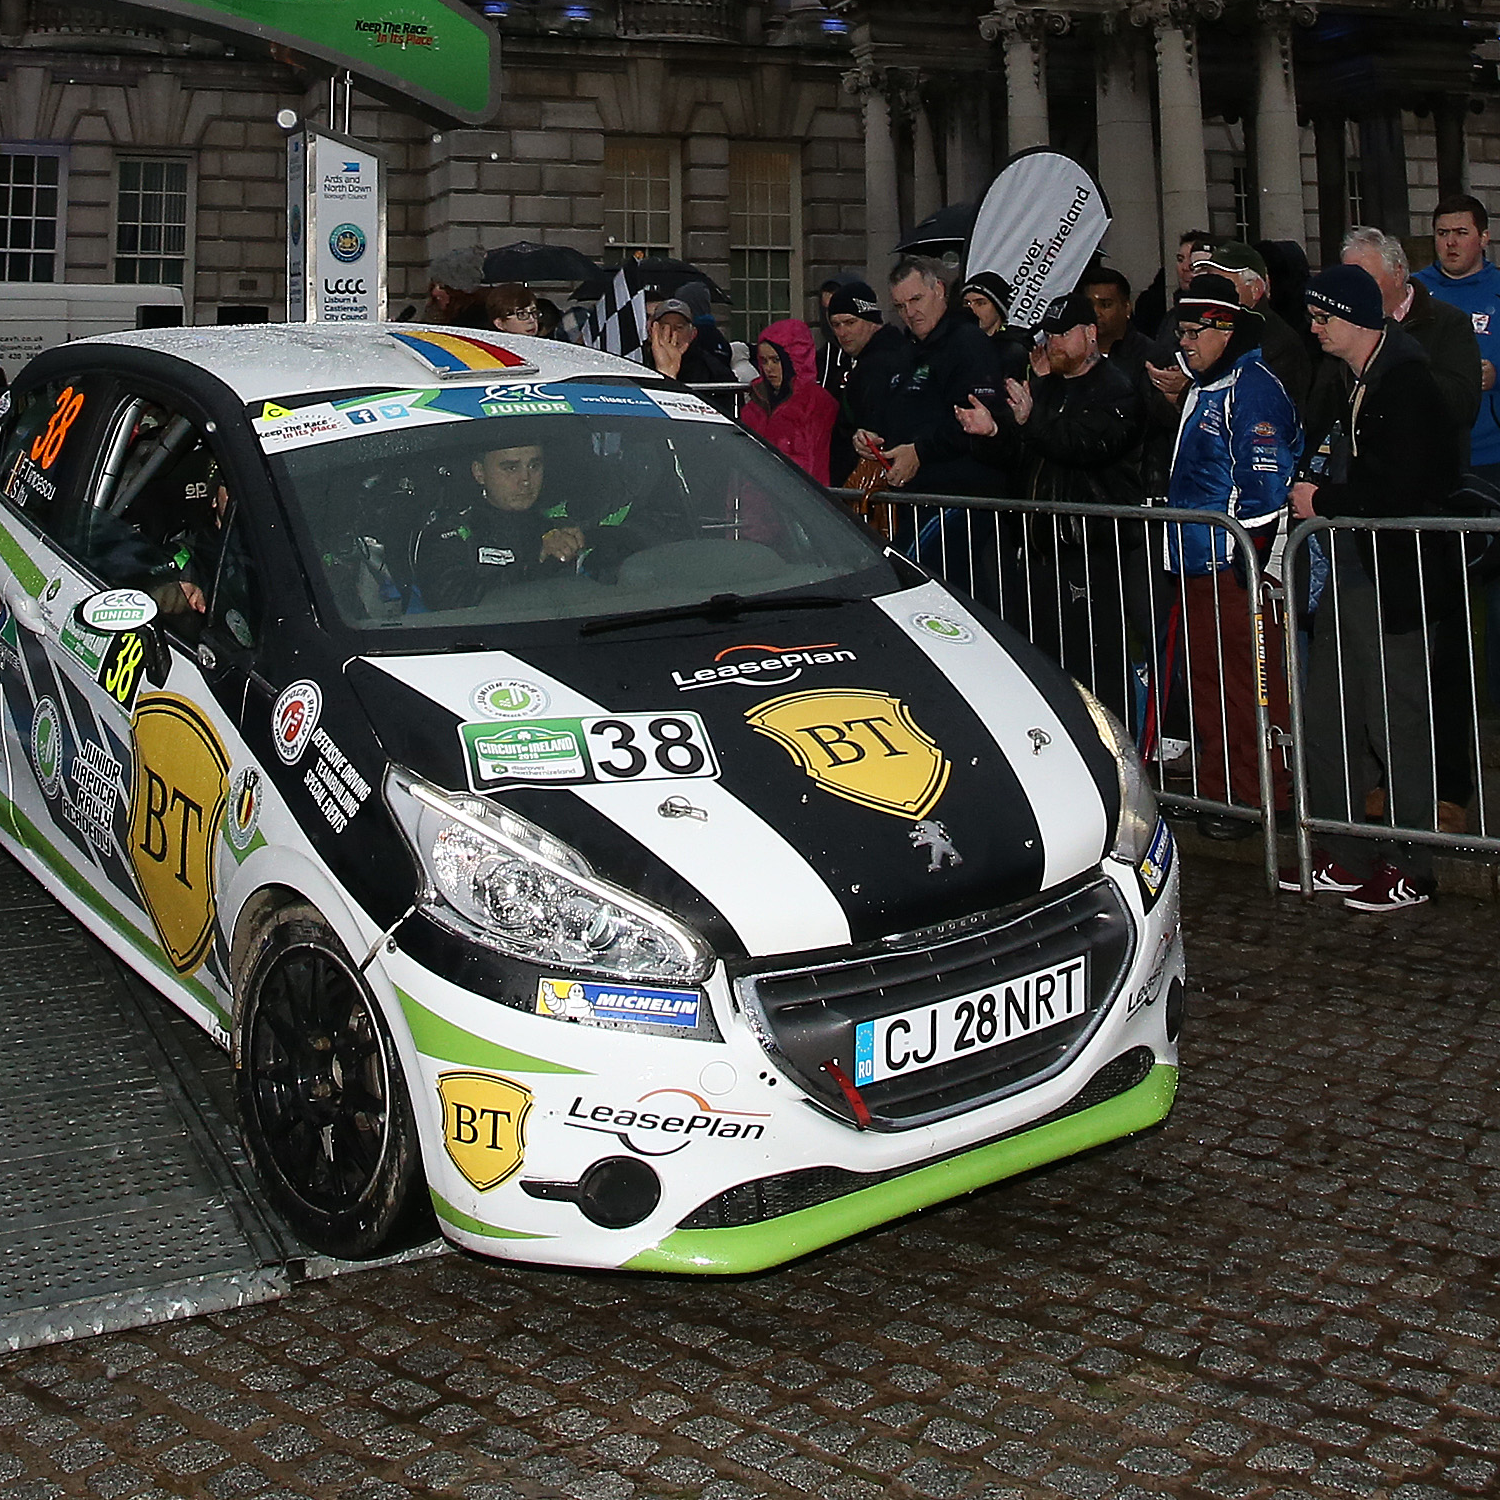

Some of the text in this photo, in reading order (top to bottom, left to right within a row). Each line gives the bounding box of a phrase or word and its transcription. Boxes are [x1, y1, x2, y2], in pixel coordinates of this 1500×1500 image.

[355, 19, 427, 35] Keep The Race
[377, 32, 387, 43] In
[405, 33, 433, 45] Place
[324, 175, 360, 184] Ards and
[324, 184, 372, 193] North Down
[324, 279, 367, 294] LCCC
[1007, 238, 1045, 310] iscover
[324, 312, 368, 322] City Council
[31, 386, 84, 470] 38
[268, 408, 282, 418] C
[284, 424, 301, 434] The
[304, 418, 327, 430] Race
[491, 402, 568, 414] JUNIOR
[310, 424, 337, 434] Place
[95, 610, 141, 621] JUNIOR
[106, 633, 143, 702] 38
[671, 650, 856, 686] LeasePlan
[479, 741, 521, 755] CIRCUIT
[528, 736, 573, 752] IRELAND
[591, 718, 704, 778] 38
[796, 716, 908, 768] BT
[81, 740, 121, 785] JUNIOR
[311, 727, 371, 802] DEFENSIVE DRIVING
[72, 758, 117, 811] NAPOCA
[303, 768, 348, 834] SPECIAL EVENTS
[315, 756, 360, 818] TEAMBUILDING
[62, 799, 111, 856] ACADEMY
[78, 788, 114, 832] RALLY
[140, 764, 203, 891] BT
[915, 913, 987, 938] PEUGEOT
[597, 993, 697, 1014] MICHELIN
[885, 1008, 937, 1071] CJ
[858, 1060, 872, 1079] RO
[451, 1101, 511, 1150] BT
[568, 1096, 766, 1140] LeasePlan
